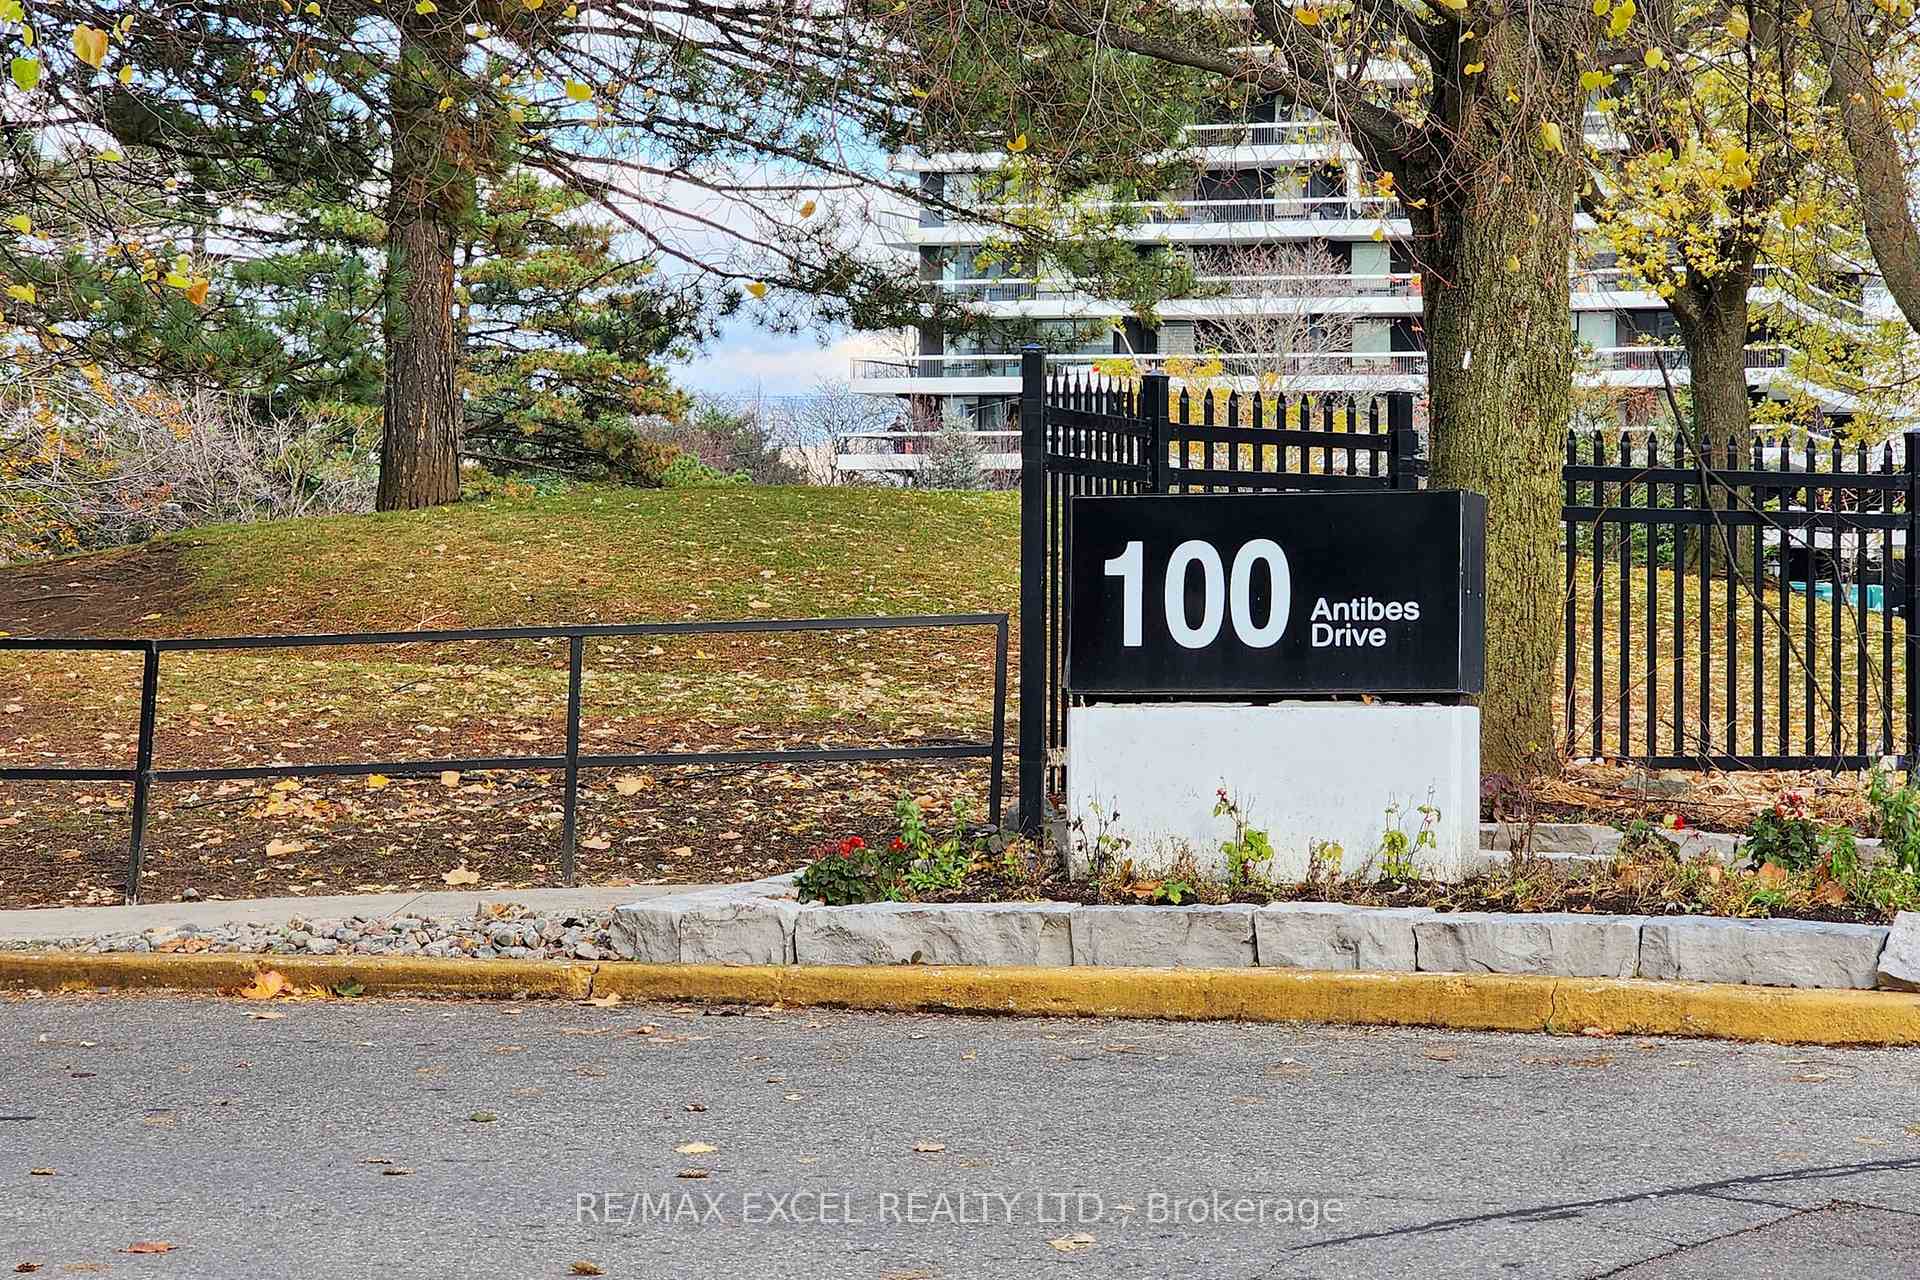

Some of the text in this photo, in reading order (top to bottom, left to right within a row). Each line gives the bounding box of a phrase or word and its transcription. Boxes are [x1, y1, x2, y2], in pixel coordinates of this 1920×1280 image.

[1104, 538, 1291, 649] 100
[1310, 596, 1420, 622] Antibes
[1311, 622, 1387, 648] Drive
